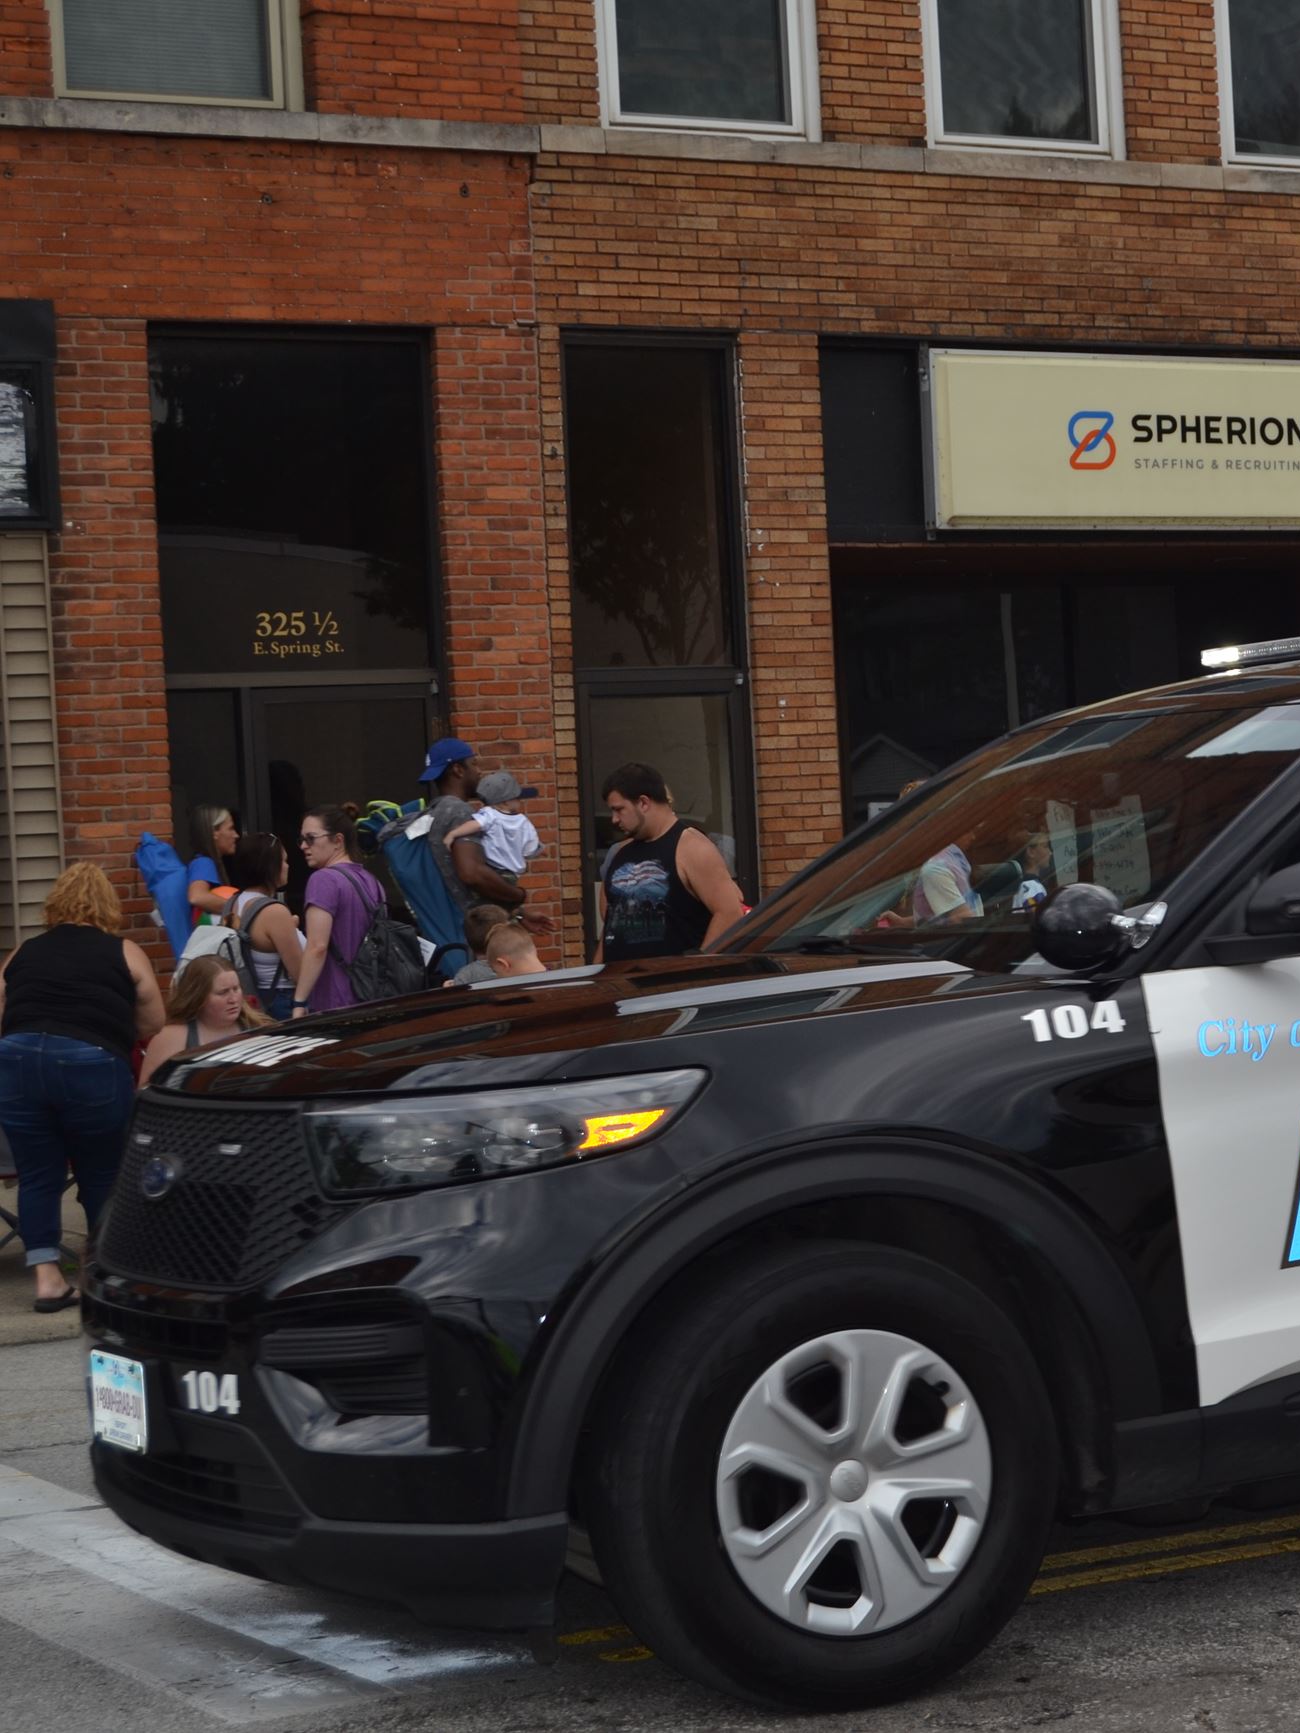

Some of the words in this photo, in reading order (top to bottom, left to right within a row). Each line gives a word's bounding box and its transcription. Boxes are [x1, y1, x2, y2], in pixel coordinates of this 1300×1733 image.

[1134, 458, 1205, 470] STAFFING
[1211, 459, 1219, 470] &
[255, 611, 306, 637] 325
[271, 641, 321, 658] Spring
[325, 640, 345, 653] St.
[1021, 1000, 1126, 1043] 104
[1197, 1017, 1276, 1062] City
[182, 1370, 241, 1415] 104
